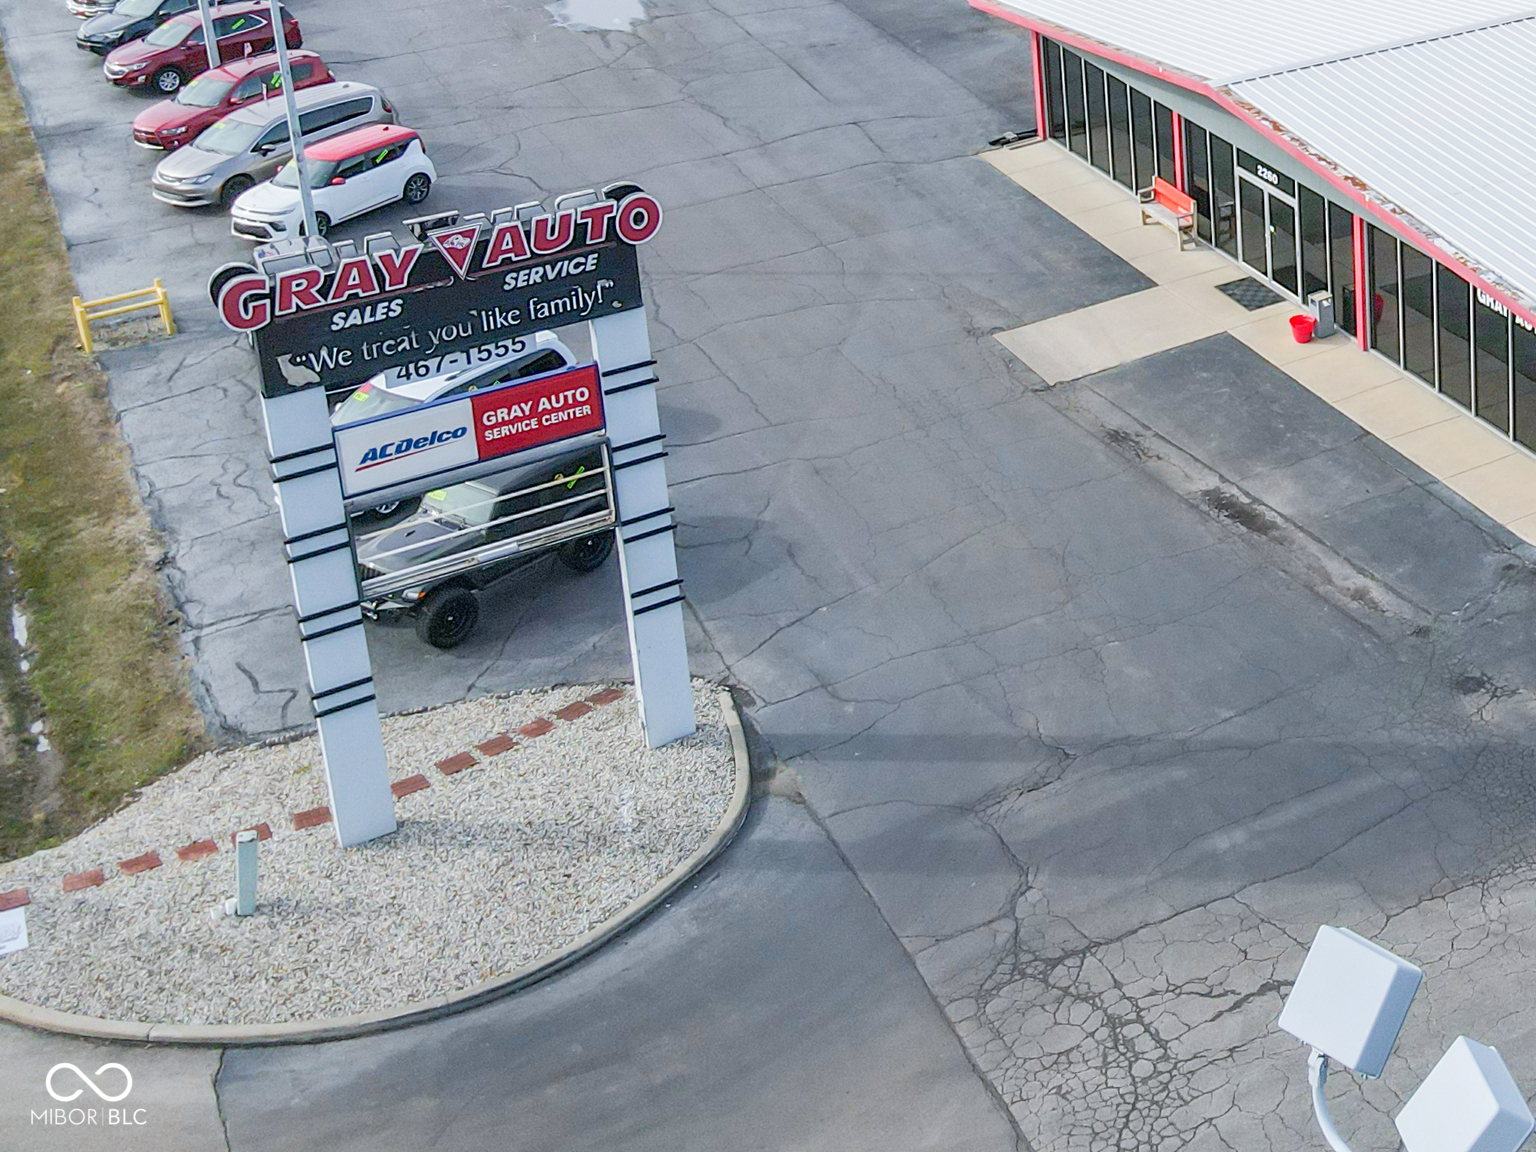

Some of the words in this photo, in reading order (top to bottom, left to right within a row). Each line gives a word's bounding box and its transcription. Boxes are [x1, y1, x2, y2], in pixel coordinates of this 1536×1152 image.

[1256, 164, 1279, 185] 2260
[218, 243, 425, 333] GRAY
[482, 192, 664, 269] AUTO
[503, 252, 599, 291] SERVICE
[330, 298, 404, 332] SALES
[426, 321, 473, 354] you
[481, 307, 521, 332] like
[396, 337, 527, 381] 467-1555
[482, 400, 534, 427] GRAY
[537, 386, 590, 413] AUTO
[484, 417, 539, 442] SERVICE
[541, 404, 592, 425] CENTER
[359, 426, 468, 465] ACDelco
